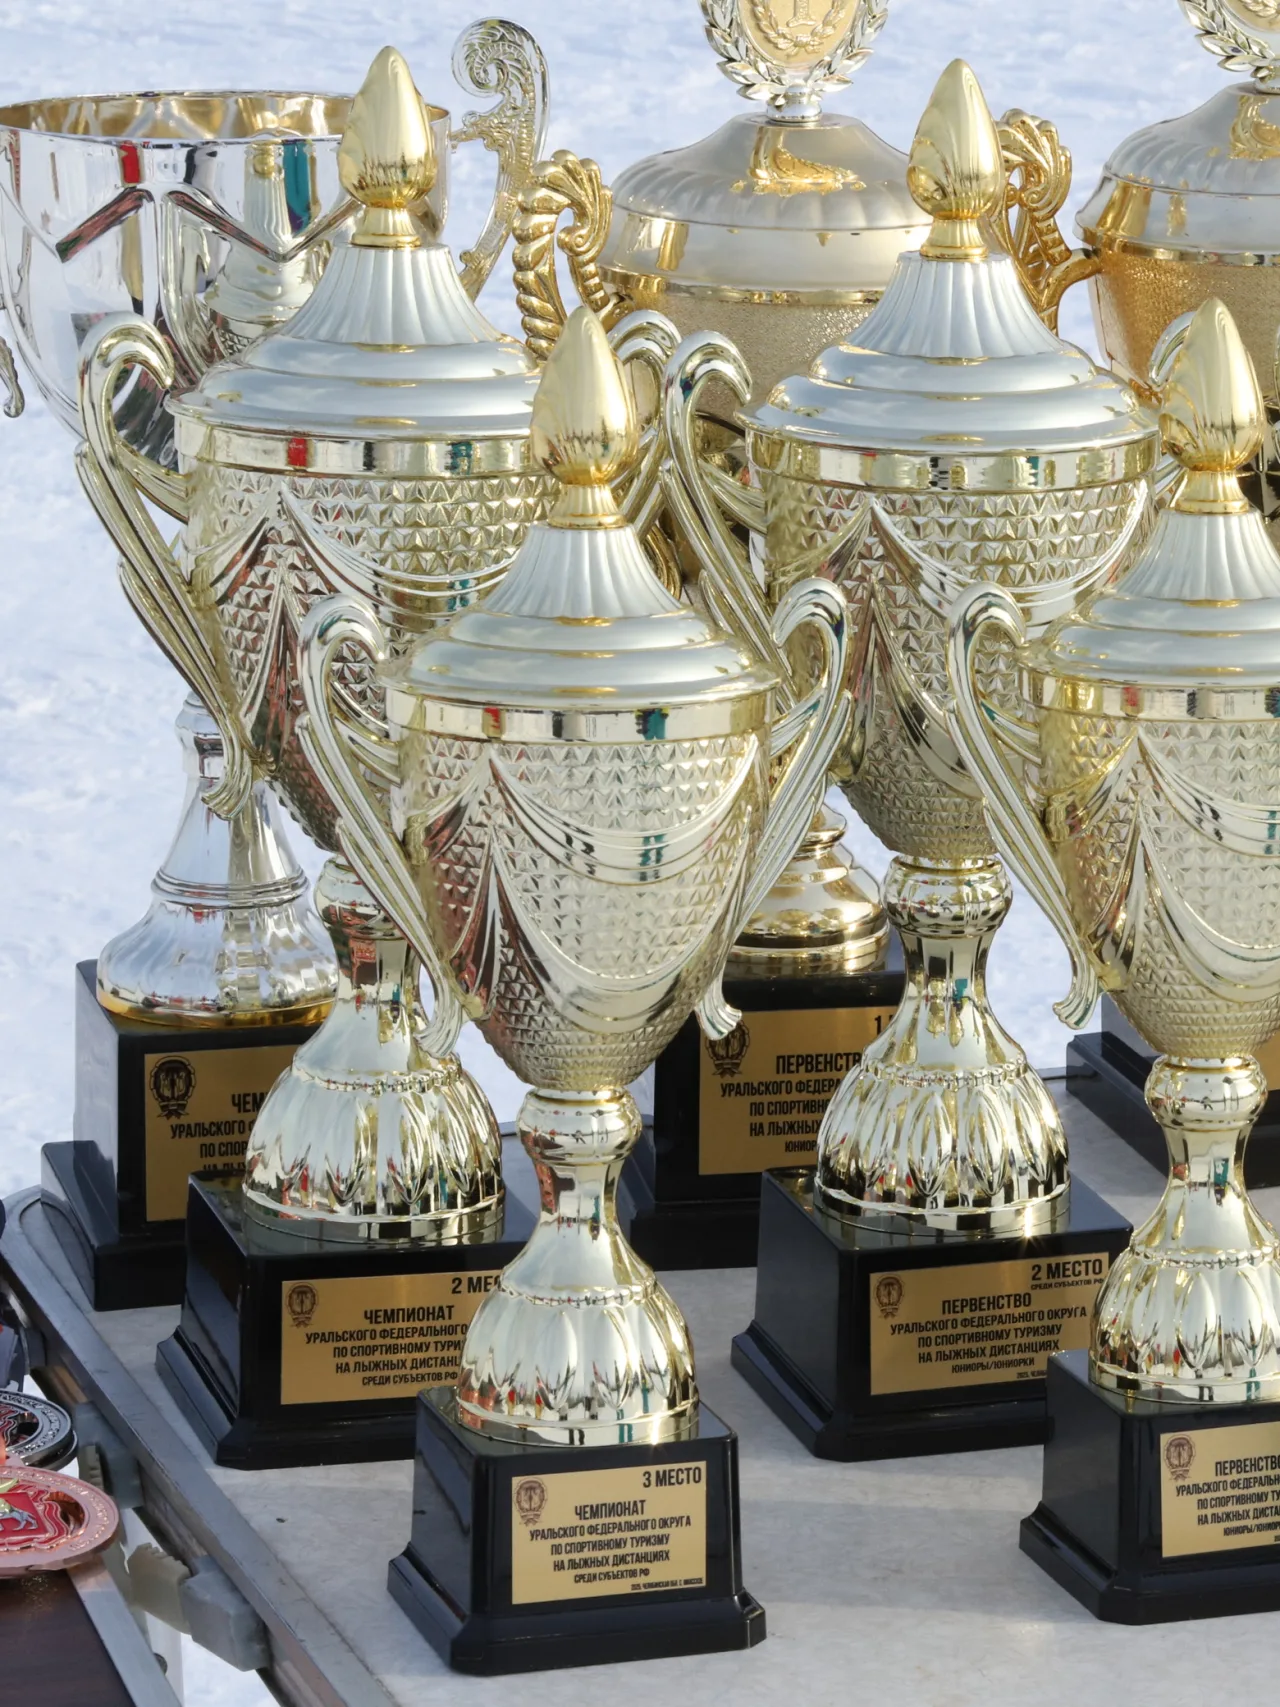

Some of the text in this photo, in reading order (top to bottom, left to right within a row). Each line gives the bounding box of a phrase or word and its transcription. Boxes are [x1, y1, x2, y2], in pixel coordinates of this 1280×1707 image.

[721, 1080, 792, 1097] УРАЛЬСКОГО
[750, 1102, 764, 1116] ПО
[171, 1120, 245, 1139] УРАЛЬСКОГО
[750, 1120, 822, 1137] НА ЛЫЖНЫХ
[200, 1143, 216, 1158] ПО
[1032, 1259, 1103, 1281] 2 МЕСТО
[452, 1278, 461, 1294] 2
[1054, 1279, 1092, 1288] СУБЪЕКТОВ
[942, 1293, 1032, 1315] ПЕРВЕНСТВО
[364, 1305, 455, 1324] ЧЕМПИОНАТ
[891, 1307, 1086, 1335] УРАЛЬСКОГО ФЕДЕРАЛЬНОГО ОКРУГА
[306, 1324, 467, 1344] УРАЛЬСКОГО ФЕДЕРАЛЬНОГО
[918, 1324, 1062, 1348] ПО СПОРТИВНОМУ ТУРИЗМУ
[333, 1346, 348, 1358] ПО
[350, 1342, 429, 1357] СПОРТИВНОМУ
[919, 1340, 1059, 1363] НА ЛЫЖНЫХ ДИСТАНЦИЯХ
[336, 1362, 350, 1374] НА
[354, 1358, 407, 1373] ЛЫЖНЫХ
[952, 1358, 1034, 1374] ЮНИОРЫ/ЮНИОРКИ
[362, 1371, 458, 1385] СРЕДИ СУБЪЕКТОВ РФ
[643, 1467, 701, 1488] 3 МЕСТО
[1176, 1480, 1227, 1496] УРАЛЬСКОГО
[575, 1500, 646, 1520] ЧЕМПИОНАТ
[1197, 1499, 1208, 1510] ПО
[1210, 1492, 1268, 1508] СПОРТИВНОМУ
[1198, 1514, 1209, 1525] НА
[1211, 1509, 1250, 1524] ЛЫЖНЫХ
[530, 1516, 691, 1541] УРАЛЬСКОГО ФЕДЕРАЛЬНОГО ОКРУГА
[551, 1534, 670, 1555] ПО СПОРТИВНОМУ ТУРИЗМУ
[554, 1550, 670, 1571] НА ЛЫЖНЫХ ДИСТАНЦИЯХ
[574, 1568, 649, 1583] СРЕДИ СУБЪЕКТОВ РФ
